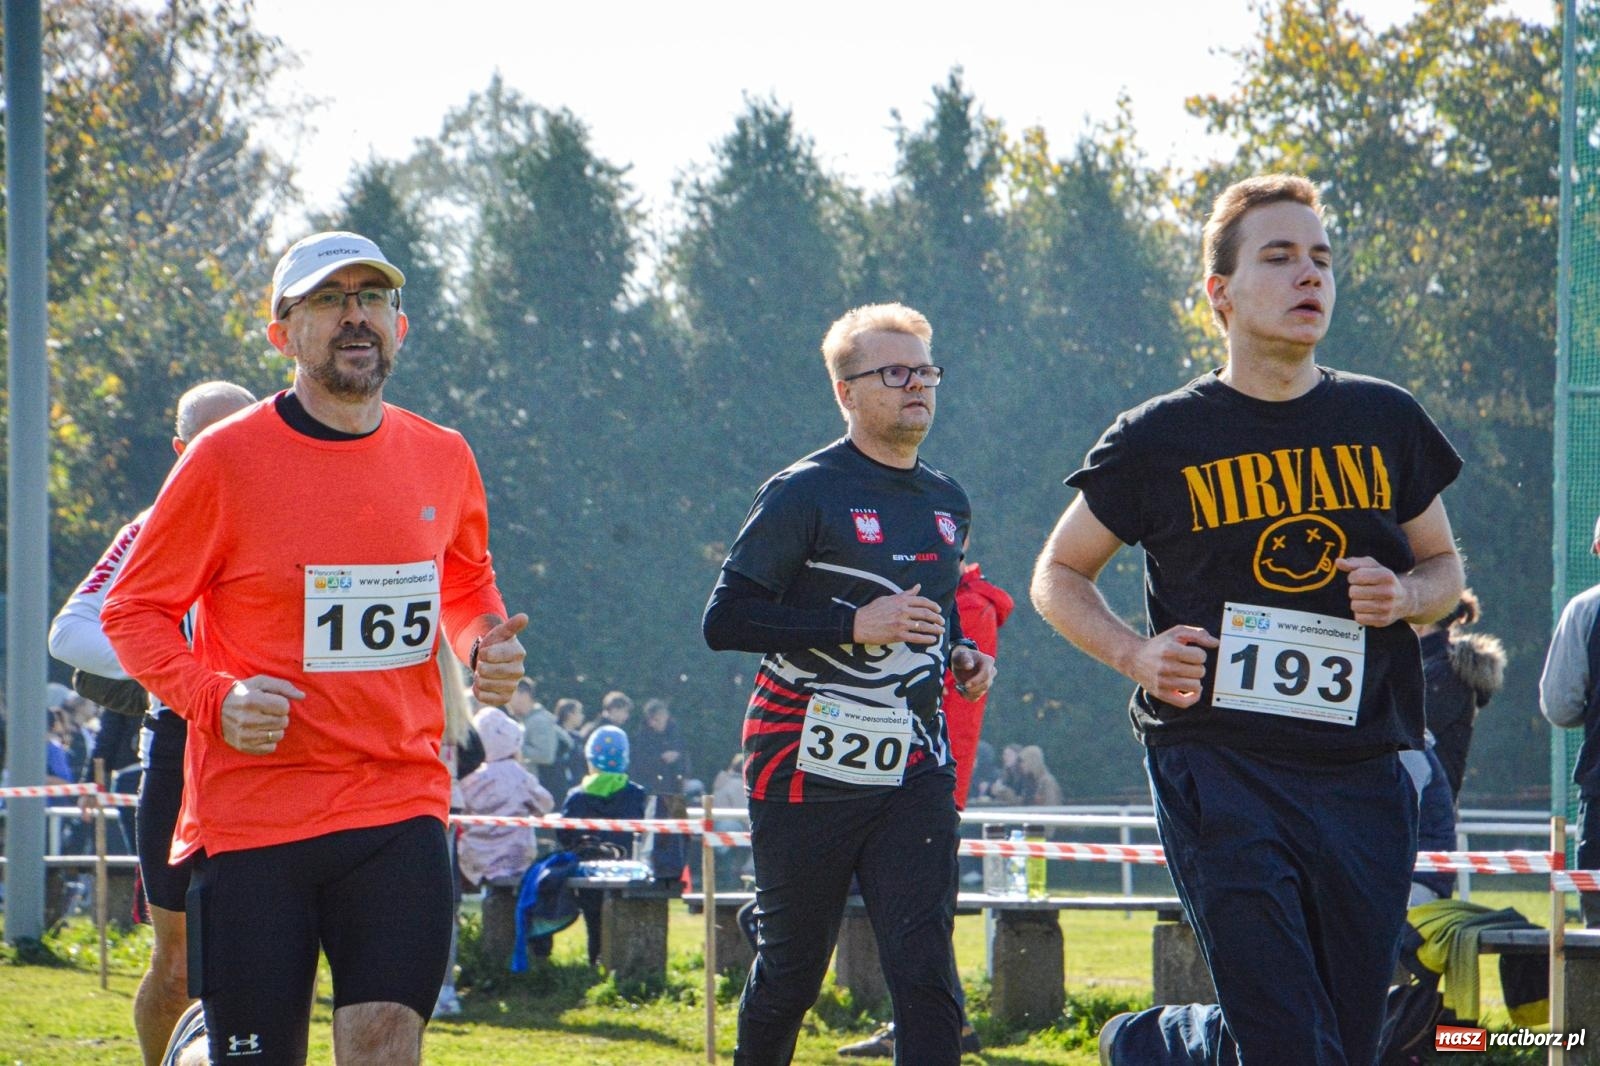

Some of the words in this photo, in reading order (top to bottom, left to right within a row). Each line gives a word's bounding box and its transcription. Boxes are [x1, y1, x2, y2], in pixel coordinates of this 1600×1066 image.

[1181, 445, 1392, 532] NIRVANA
[359, 572, 435, 587] www.personalbest.pl
[317, 600, 432, 651] 165
[1277, 621, 1360, 641] www.personalbest.pl
[1230, 643, 1353, 703] 193
[844, 711, 909, 725] www.personalbest.pl
[807, 725, 902, 771] 320
